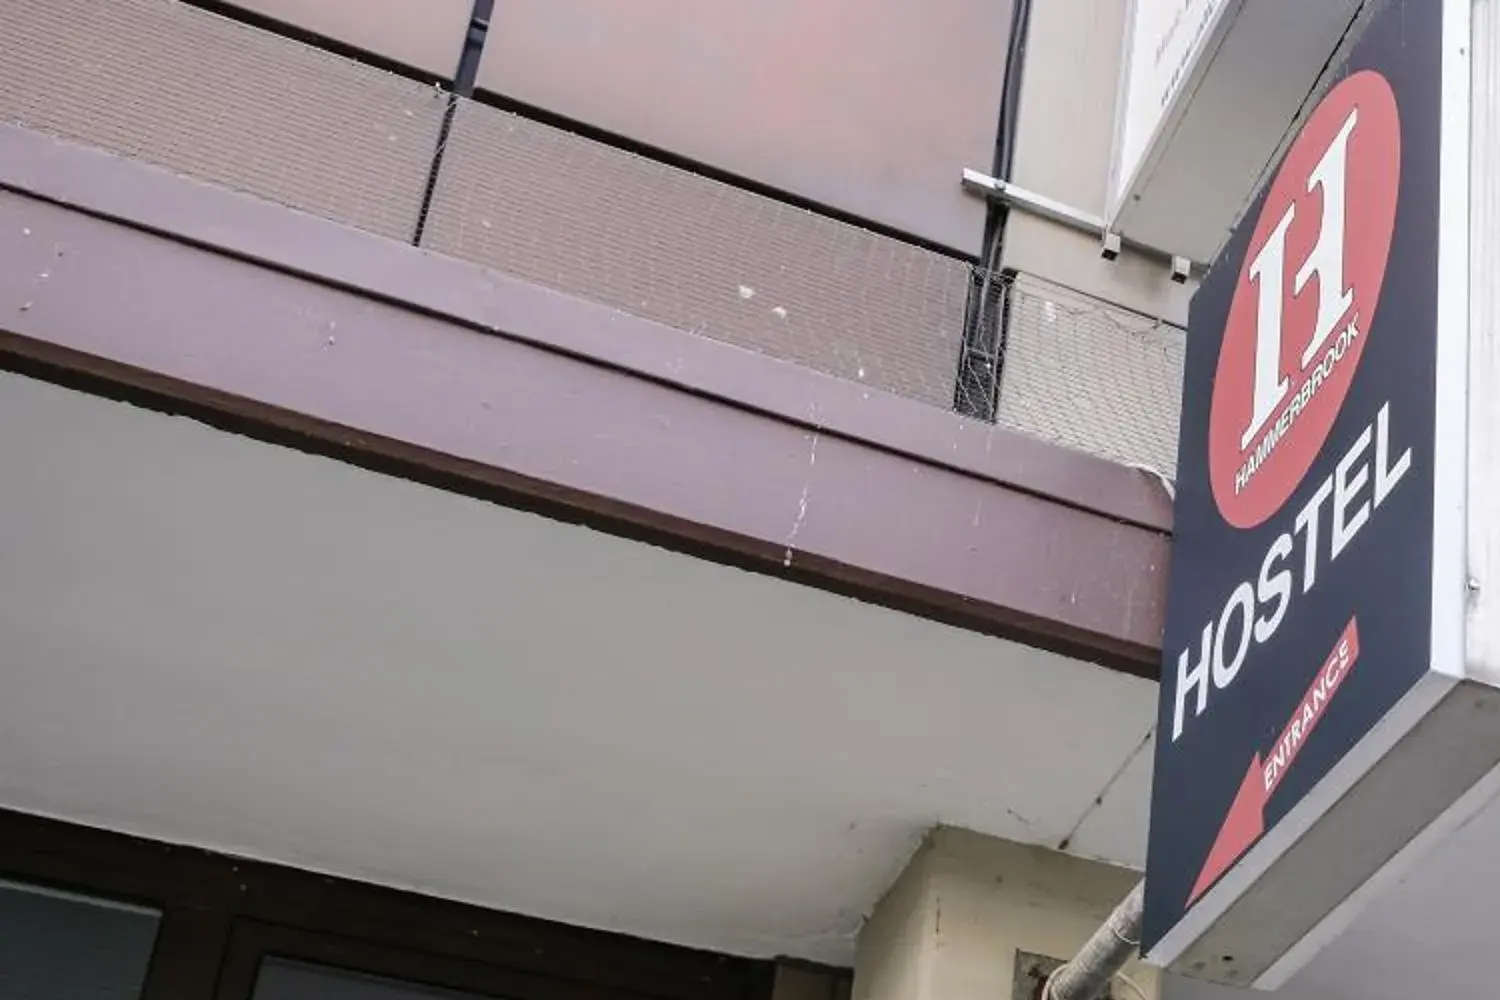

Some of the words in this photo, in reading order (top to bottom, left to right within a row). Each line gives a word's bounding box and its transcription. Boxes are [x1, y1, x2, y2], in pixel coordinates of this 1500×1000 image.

[1235, 312, 1360, 496] HAMMERBROOK
[1171, 400, 1413, 742] HOSTEL
[1264, 639, 1350, 793] ENTRANCE
